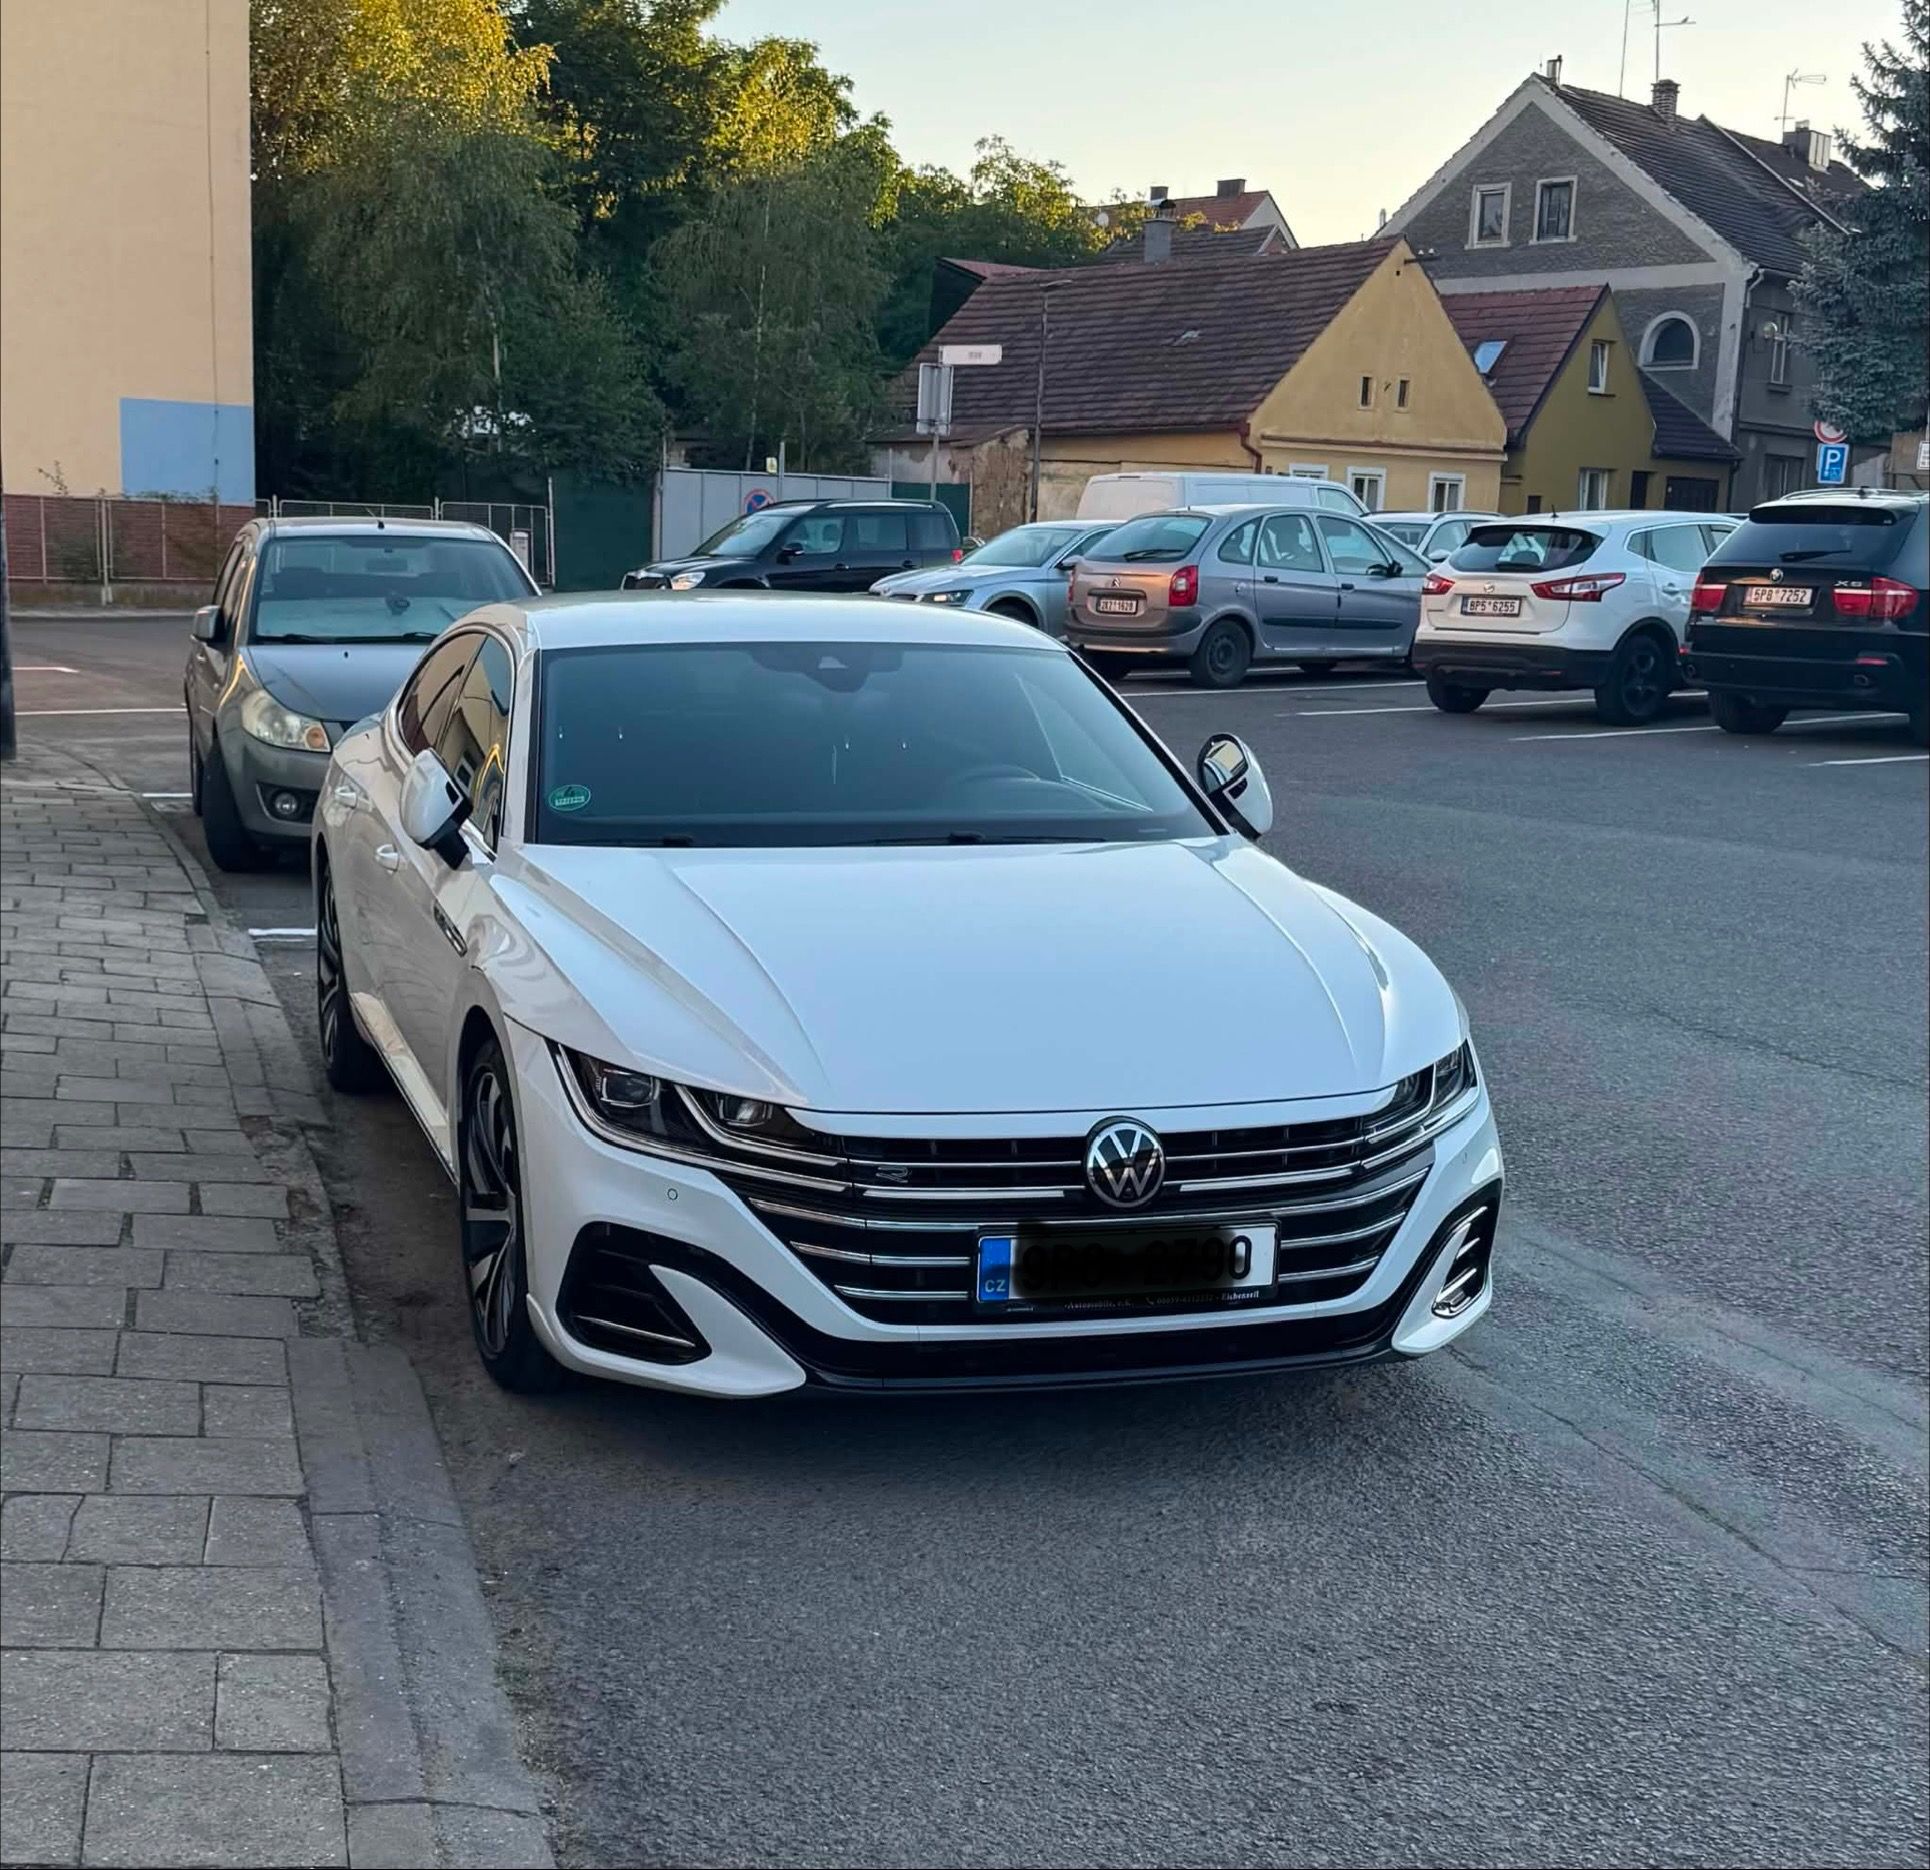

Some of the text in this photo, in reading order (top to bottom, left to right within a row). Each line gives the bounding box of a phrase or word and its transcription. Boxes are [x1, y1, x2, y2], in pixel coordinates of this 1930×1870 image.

[1824, 449, 1841, 477] P
[1780, 589, 1807, 603] 7252
[1492, 601, 1516, 612] 6255
[984, 1278, 1006, 1293] CZ
